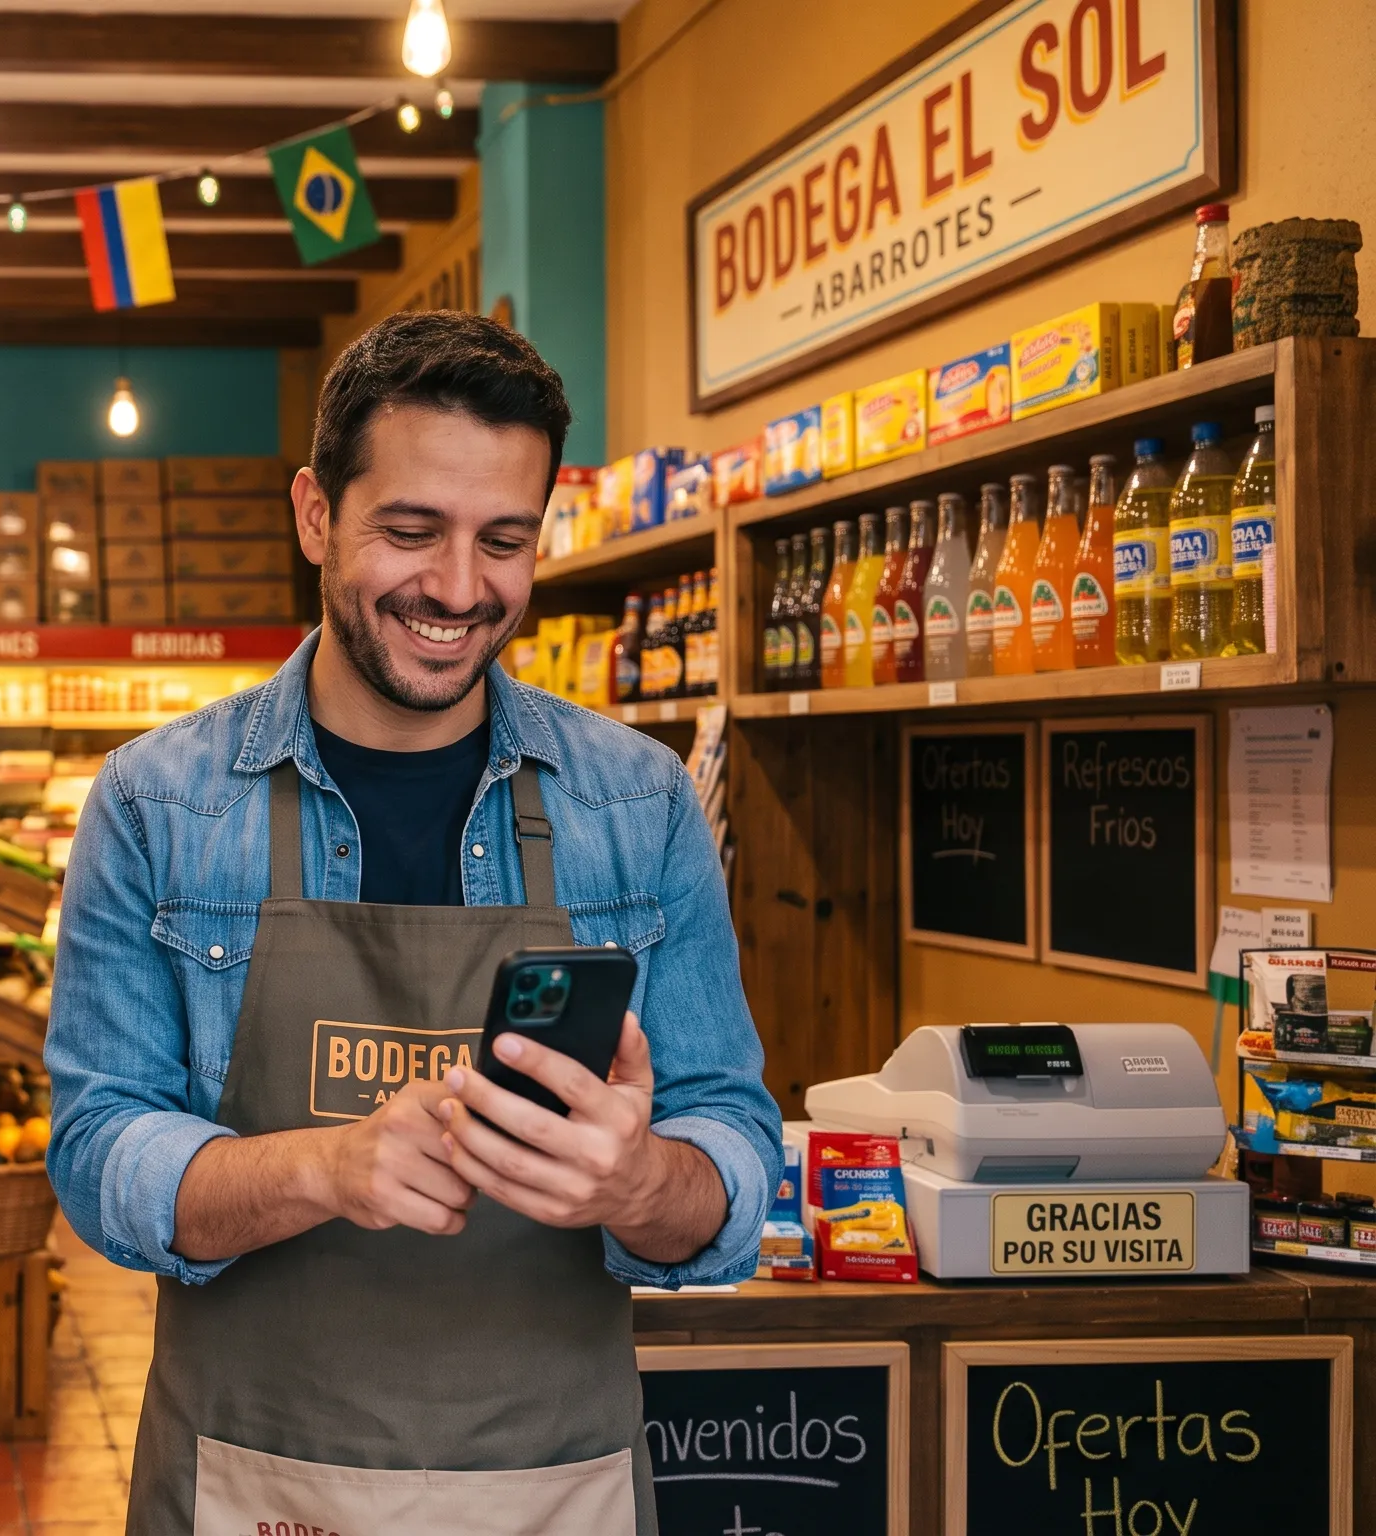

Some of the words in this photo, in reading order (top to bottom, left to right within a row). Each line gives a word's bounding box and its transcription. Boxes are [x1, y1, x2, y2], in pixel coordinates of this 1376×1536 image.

[715, 122, 901, 317] BODEGA
[921, 69, 994, 208] EL
[1016, 0, 1167, 152] SOL
[810, 195, 995, 320] ABARROTES
[923, 745, 1011, 790] Ofertas
[1063, 739, 1191, 800] Refrescos
[941, 802, 984, 864] Hoy
[328, 1036, 473, 1083] BODEGA
[1026, 1202, 1162, 1232] GRACIAS
[1003, 1241, 1054, 1264] POR
[1063, 1240, 1095, 1264] SU
[1104, 1239, 1183, 1263] VISITA
[993, 1380, 1261, 1490] Ofertas
[1080, 1477, 1198, 1536] Hoy
